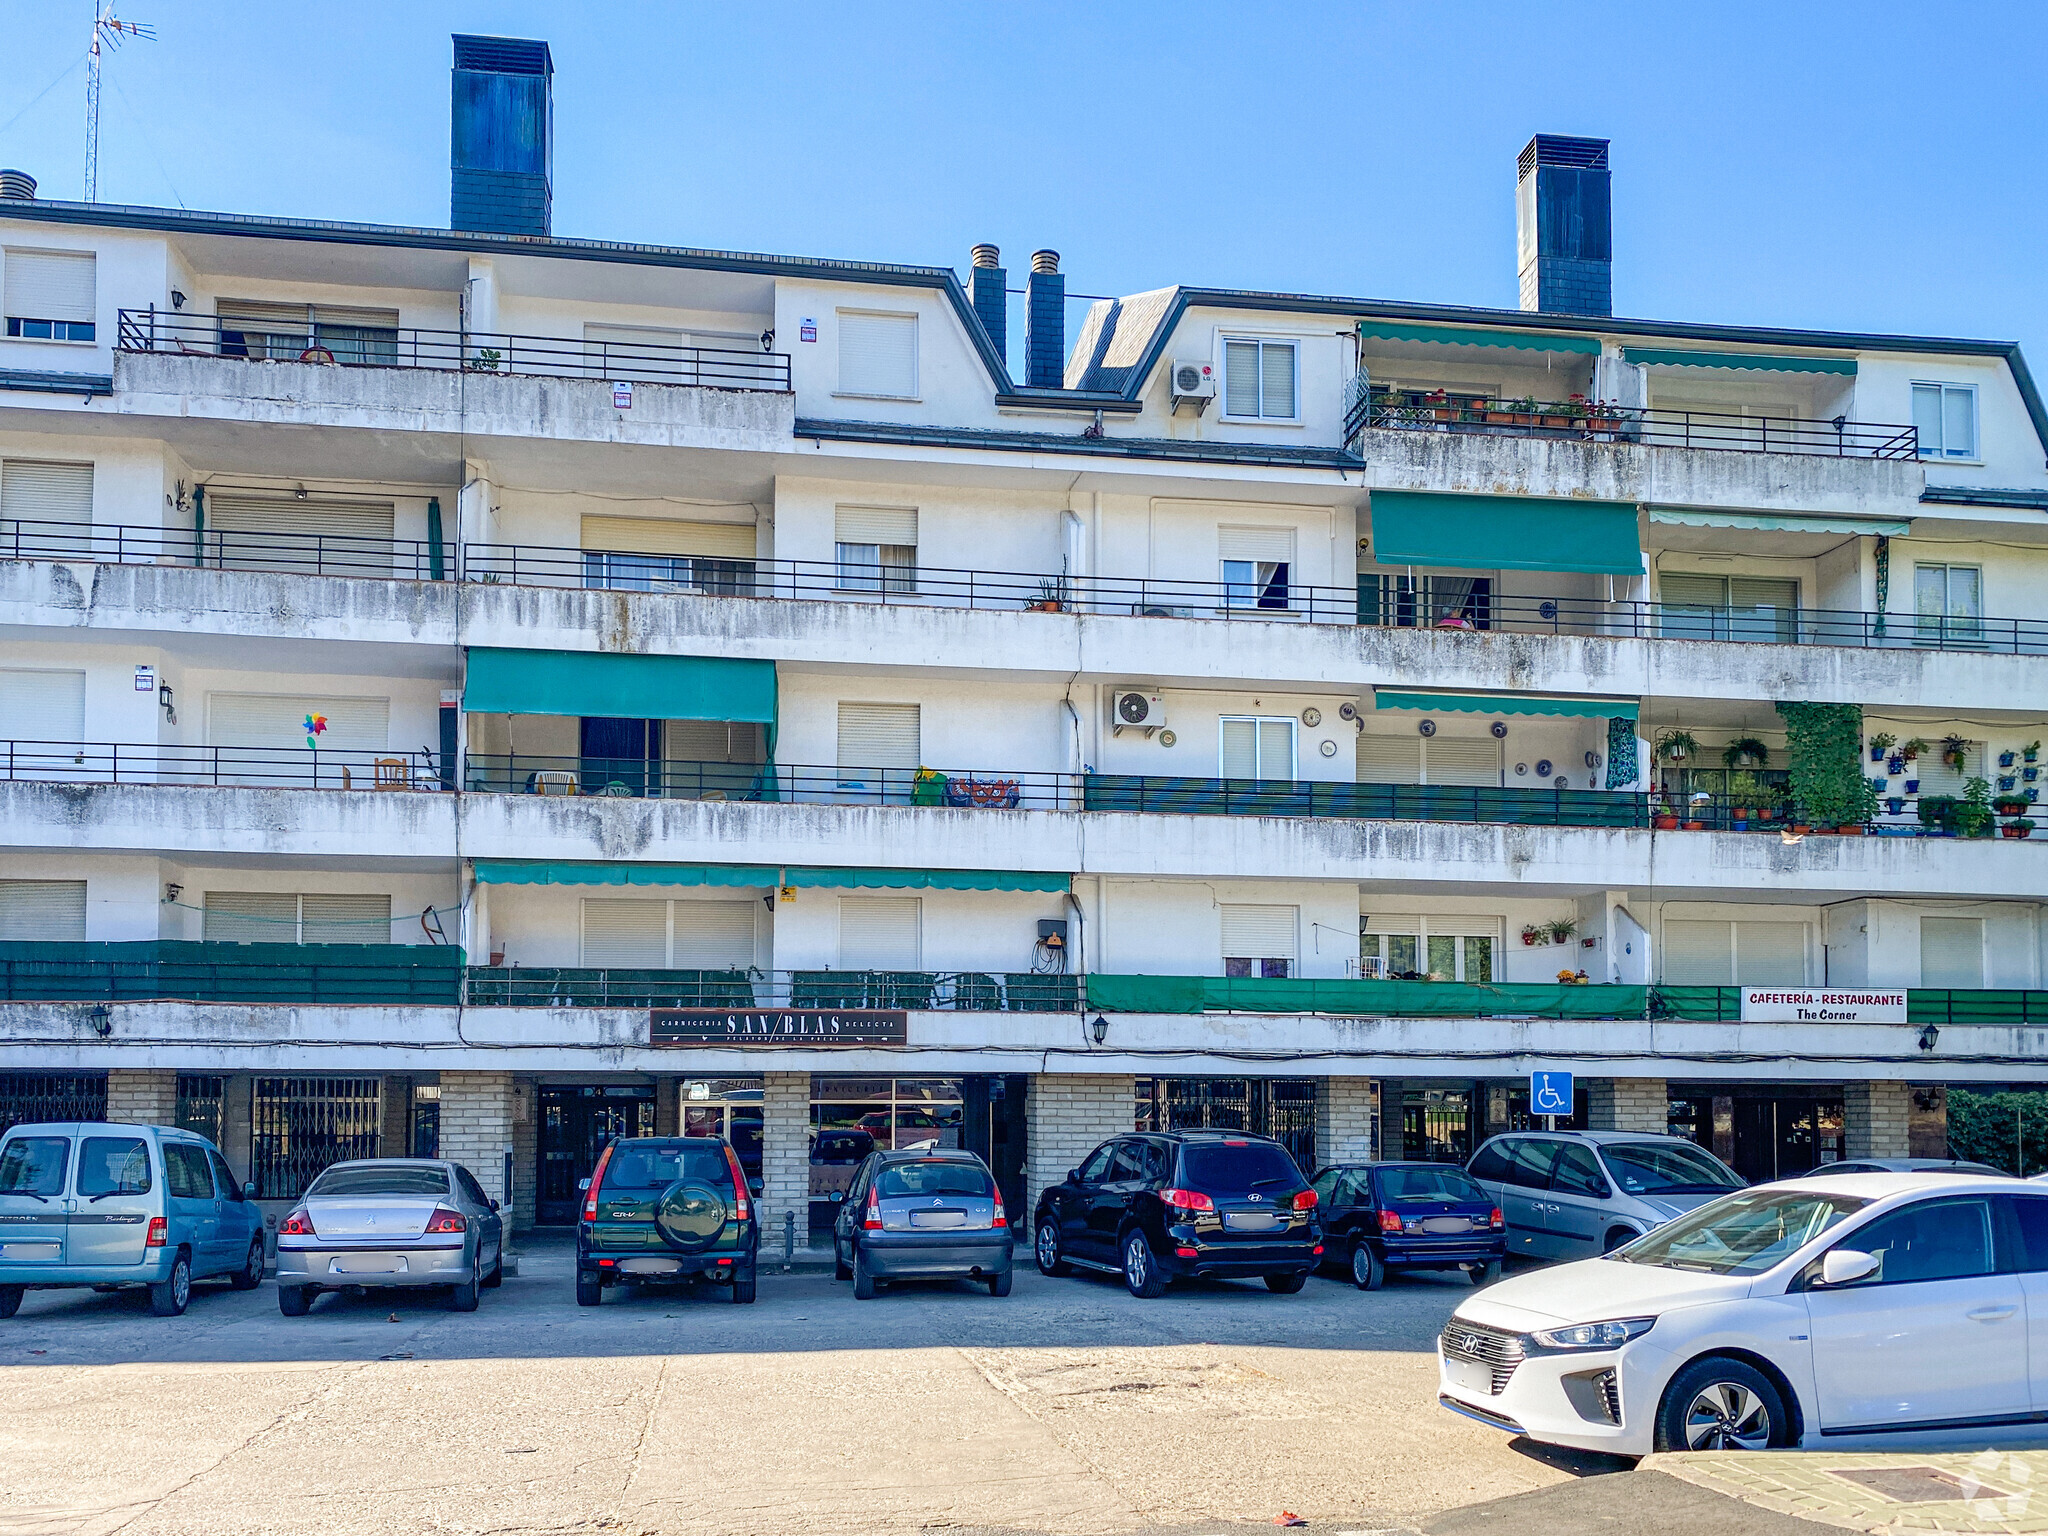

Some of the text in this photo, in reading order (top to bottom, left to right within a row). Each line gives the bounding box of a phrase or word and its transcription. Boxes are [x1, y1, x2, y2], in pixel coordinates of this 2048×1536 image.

[1749, 991, 1813, 1005] CAFETERÍA
[1821, 993, 1903, 1006] RESTAURANTE
[1796, 1008, 1857, 1021] The Corner
[514, 1086, 522, 1096] 4
[1495, 1088, 1501, 1099] 2
